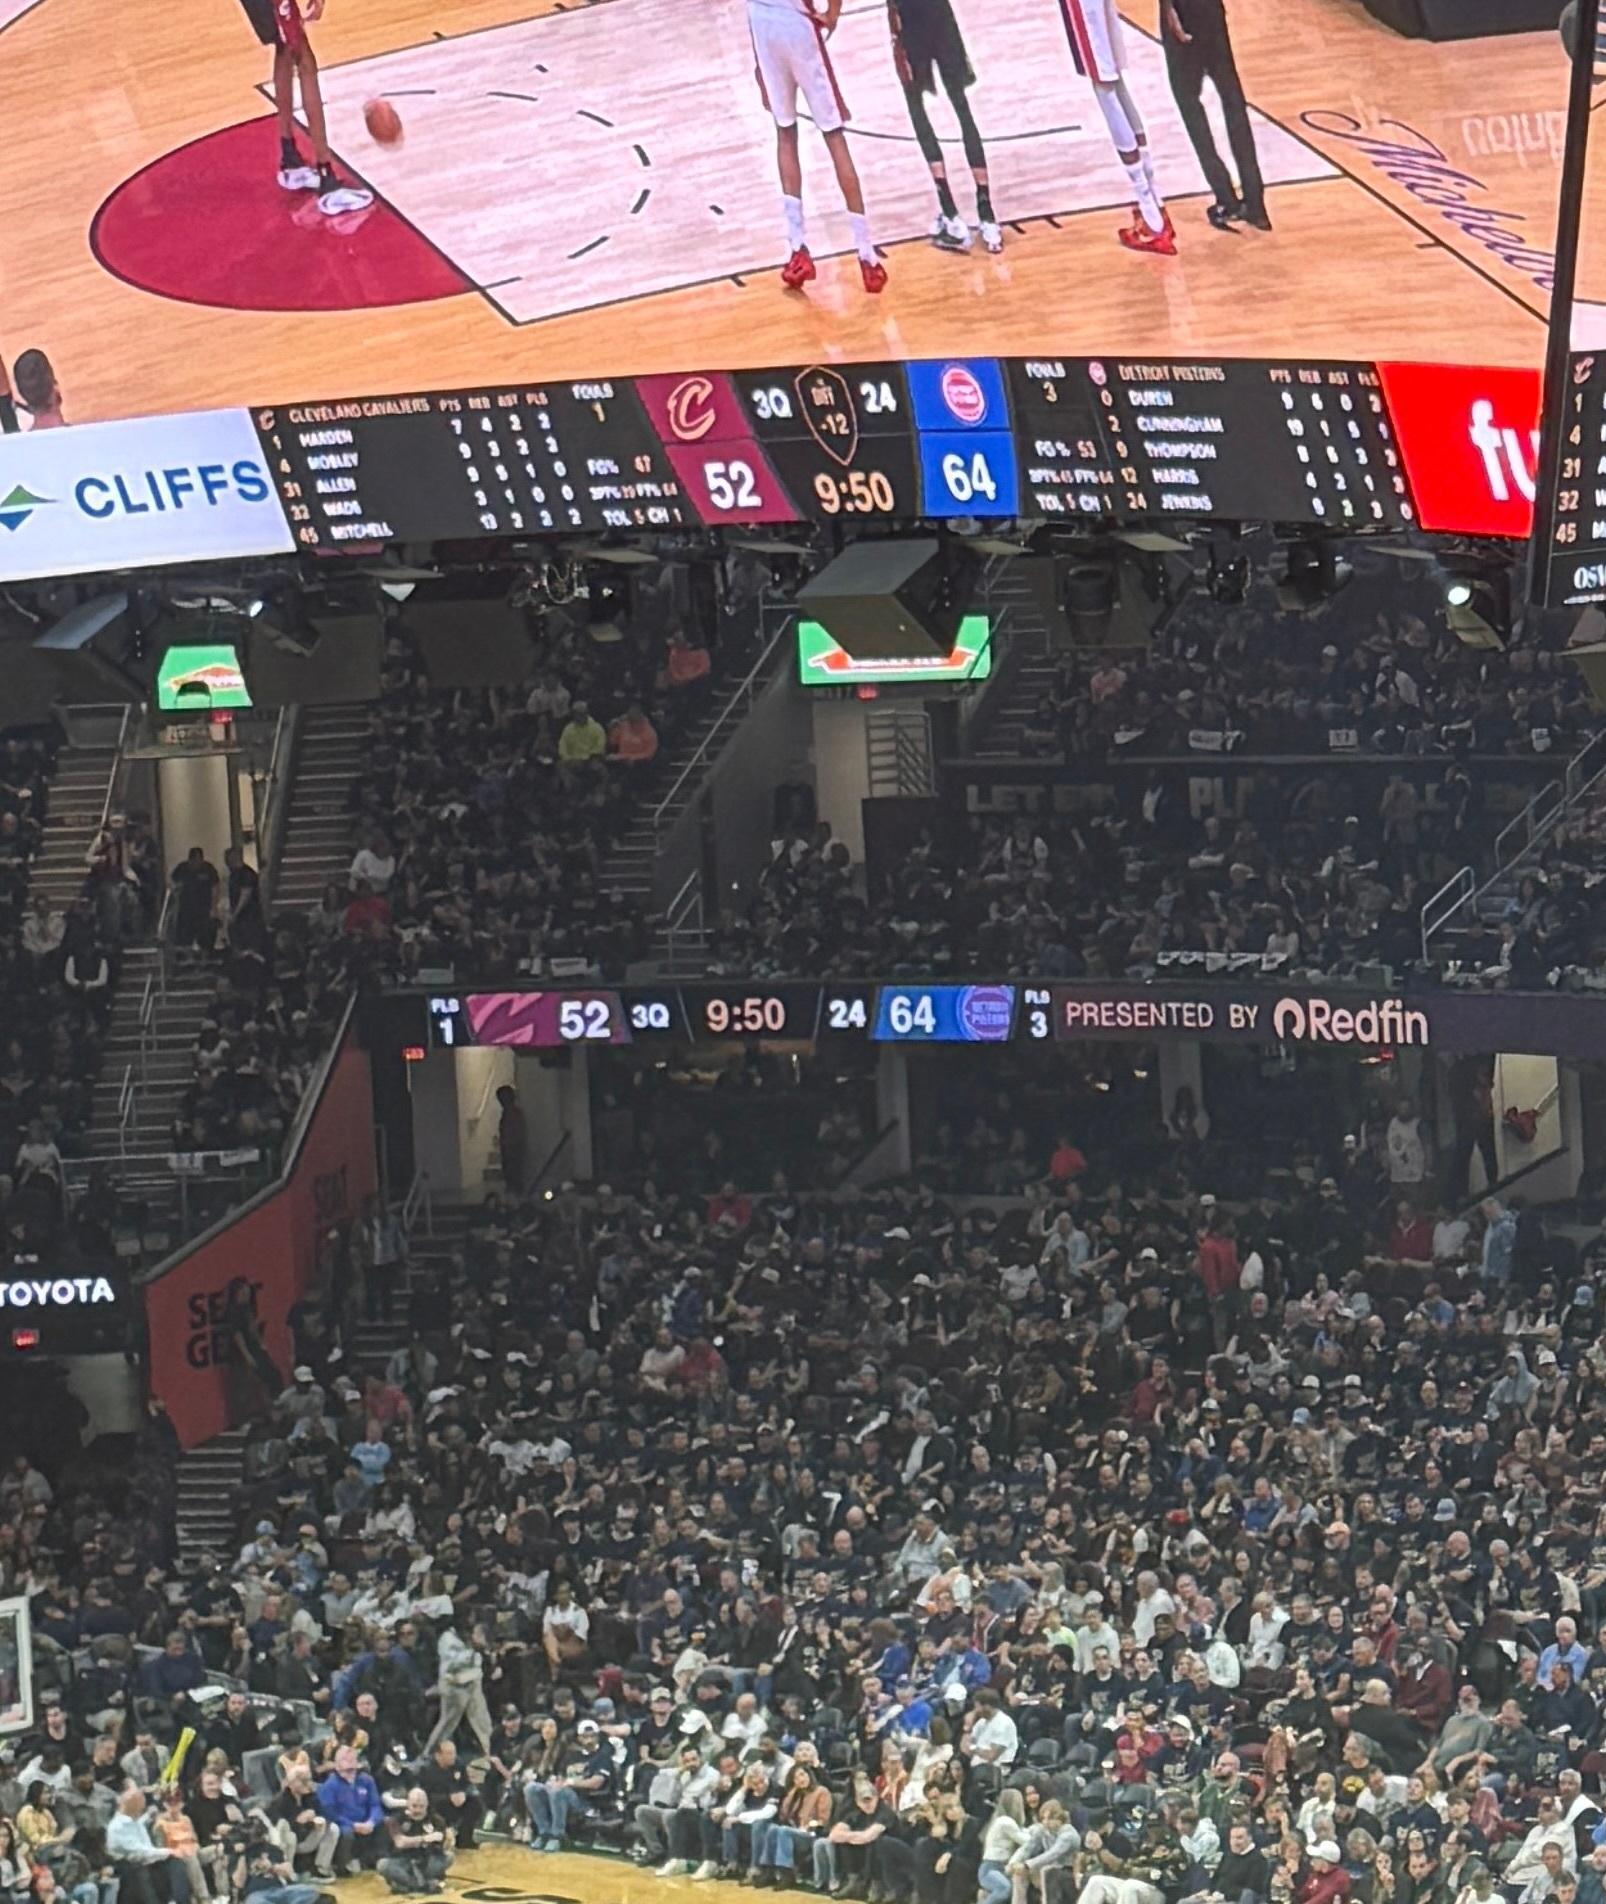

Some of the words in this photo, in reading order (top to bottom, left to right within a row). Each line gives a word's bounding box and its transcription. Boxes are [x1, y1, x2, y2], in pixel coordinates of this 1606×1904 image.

[752, 387, 793, 419] 3Q
[859, 381, 897, 413] 24
[942, 451, 997, 502] 64
[1562, 457, 1581, 478] 31
[74, 458, 270, 519] CLIFFS
[703, 460, 762, 510] 52
[814, 470, 895, 515] 9:50
[1558, 490, 1579, 512] 32
[1555, 522, 1577, 543] 45
[559, 999, 610, 1040] 52
[631, 1003, 670, 1030] 3Q
[707, 998, 786, 1034] 9:50
[829, 999, 867, 1030] 24
[889, 996, 936, 1035] 64
[1030, 1010, 1049, 1039] 3
[1065, 1001, 1215, 1030] PRESENTED
[1229, 1002, 1259, 1030] BY
[1309, 998, 1429, 1046] Redfin
[439, 1017, 454, 1045] 1
